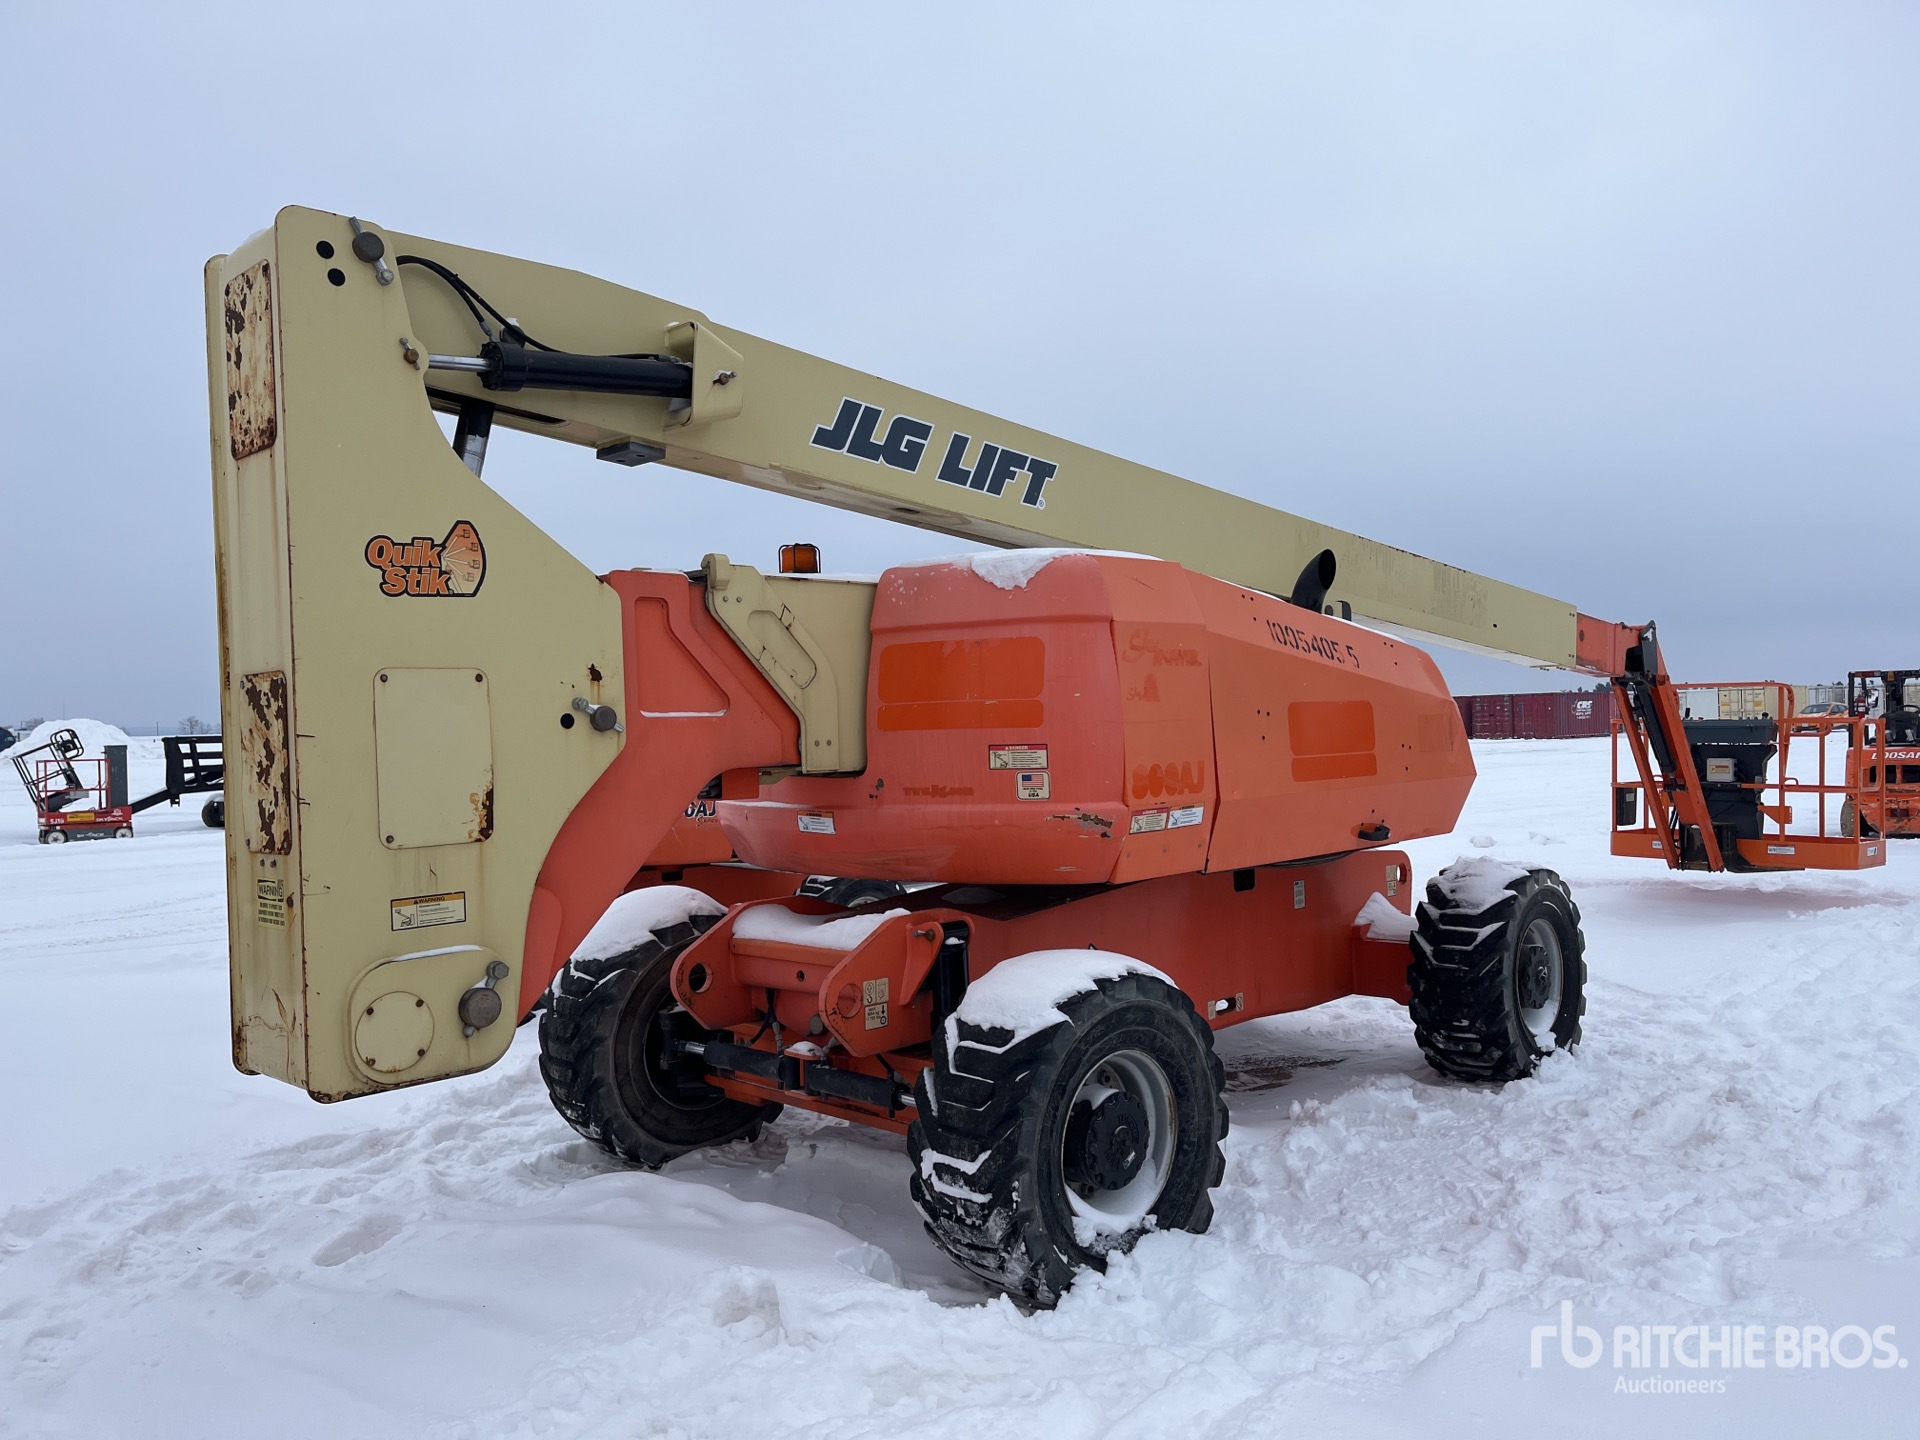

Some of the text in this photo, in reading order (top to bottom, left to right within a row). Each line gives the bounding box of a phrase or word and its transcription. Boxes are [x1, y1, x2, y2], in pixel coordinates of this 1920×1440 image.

[809, 396, 1060, 508] JLG LIFT
[367, 537, 443, 571] Quik
[382, 566, 451, 595] Stik
[258, 884, 284, 898] WARNING
[418, 896, 446, 905] WARNING
